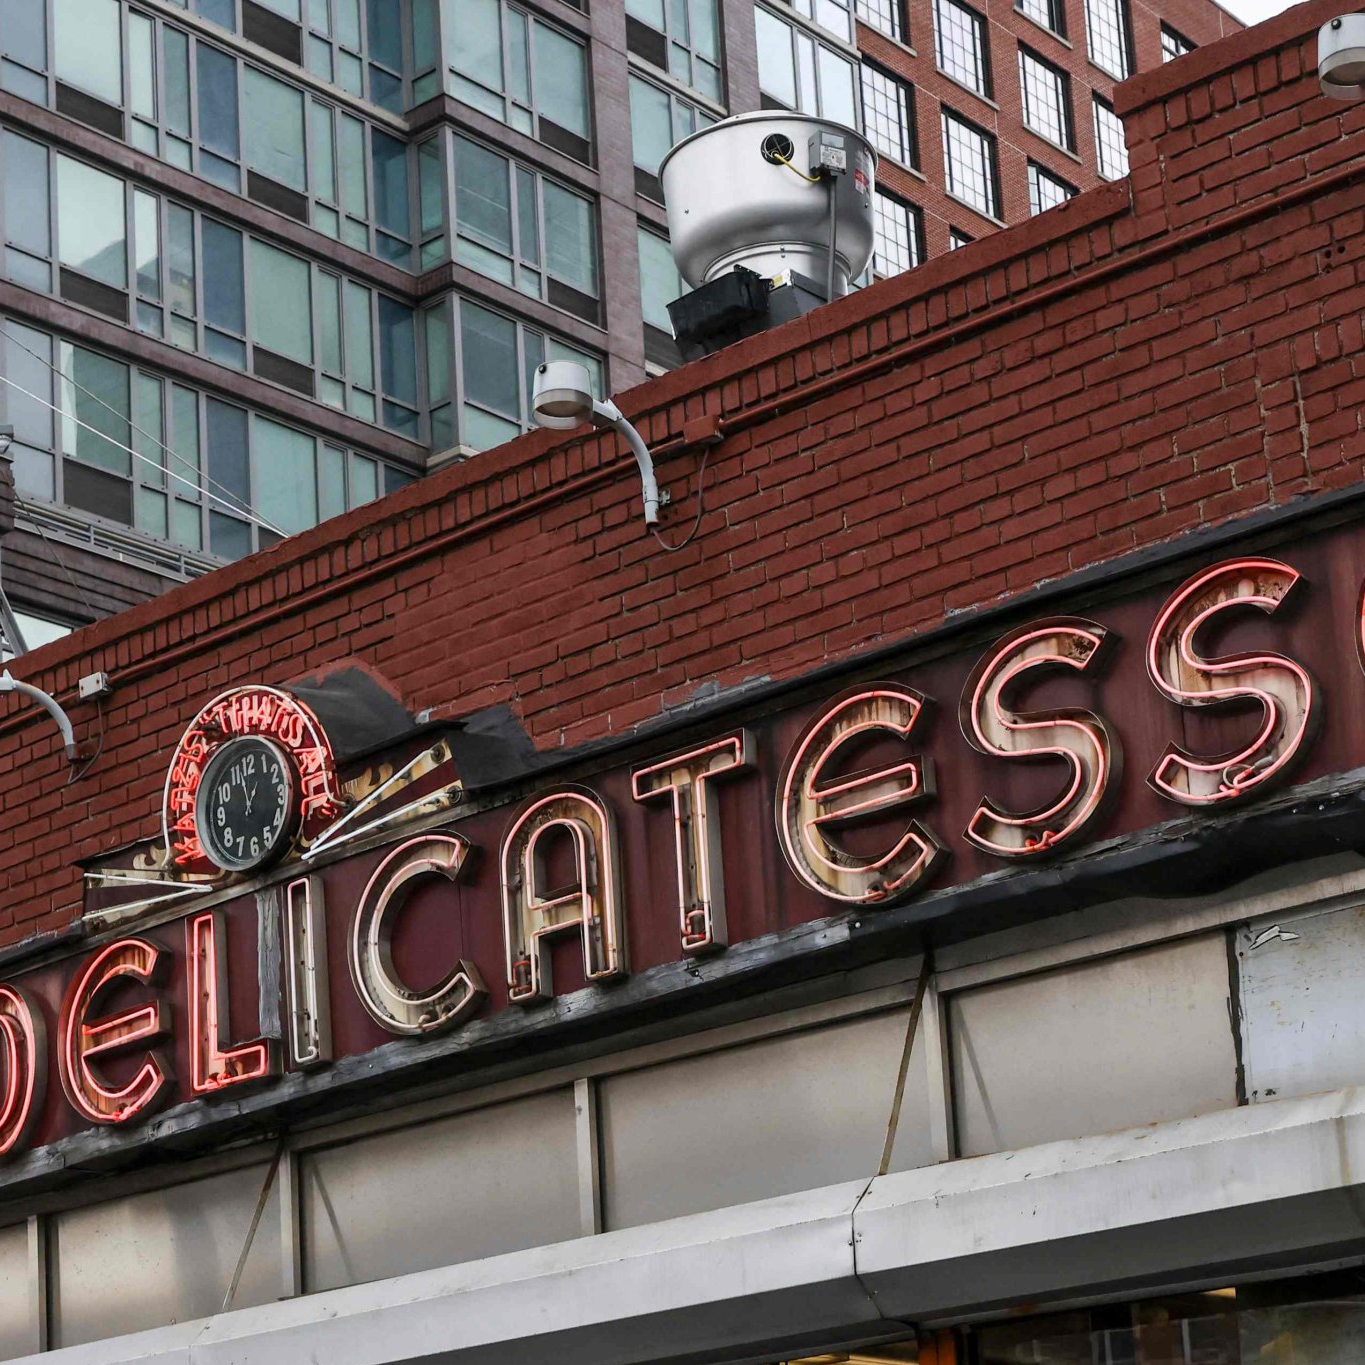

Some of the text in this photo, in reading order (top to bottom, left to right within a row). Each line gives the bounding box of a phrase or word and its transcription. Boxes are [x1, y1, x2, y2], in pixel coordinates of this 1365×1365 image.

[241, 754, 255, 776] 12
[261, 754, 268, 773] 1
[270, 763, 280, 784] 2
[230, 765, 241, 785] 11
[218, 782, 231, 804] 10
[277, 784, 285, 804] 3
[217, 807, 226, 827] 9
[273, 808, 281, 826] 4
[223, 827, 233, 847] 8
[236, 836, 245, 857] 7
[250, 836, 259, 857] 6
[263, 826, 272, 847] 5
